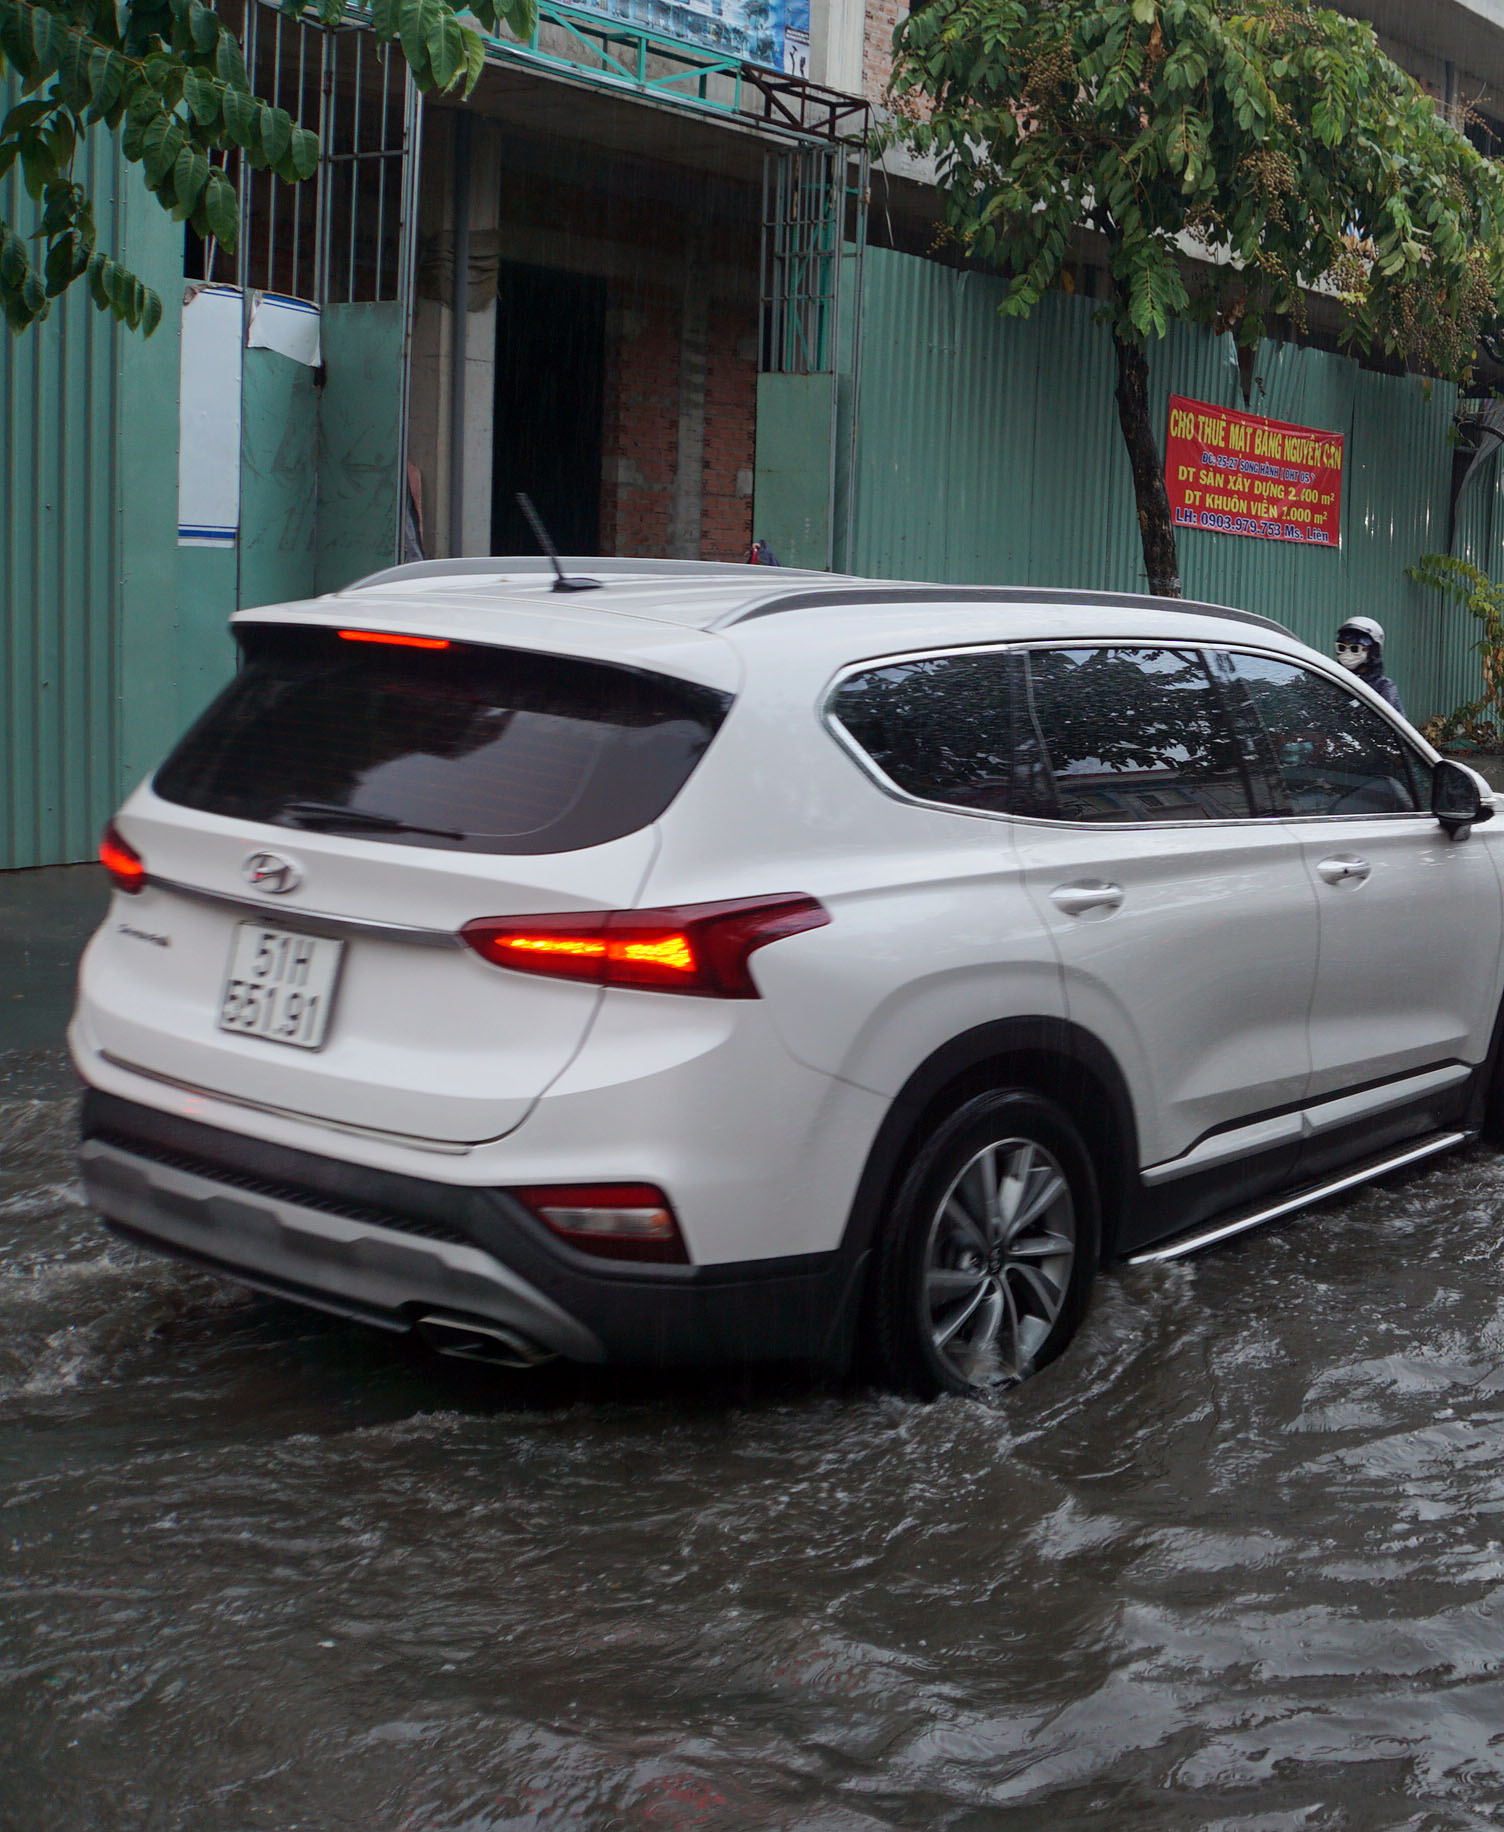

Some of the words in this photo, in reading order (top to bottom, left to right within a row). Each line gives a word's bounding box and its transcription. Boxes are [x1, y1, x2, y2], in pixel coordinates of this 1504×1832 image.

[1170, 408, 1195, 440] CHO
[1198, 413, 1227, 448] THUÊ
[1229, 420, 1254, 459] MẶT
[1283, 434, 1322, 467] NGUYÊN
[1217, 454, 1238, 470] 25-27
[1240, 459, 1259, 475] SONG
[1260, 461, 1280, 479] HÀNH
[1227, 473, 1251, 493] XÂY
[1253, 480, 1285, 499] DỰNG
[1175, 506, 1198, 525] LH:
[1200, 511, 1281, 537] 0903.979.753
[1284, 523, 1304, 540] Ms.
[1306, 525, 1329, 542] Liên
[1205, 494, 1248, 514] KHUÔN
[1250, 499, 1278, 519] VIÊN
[1281, 505, 1312, 523] 1.000
[253, 933, 315, 986] 51H
